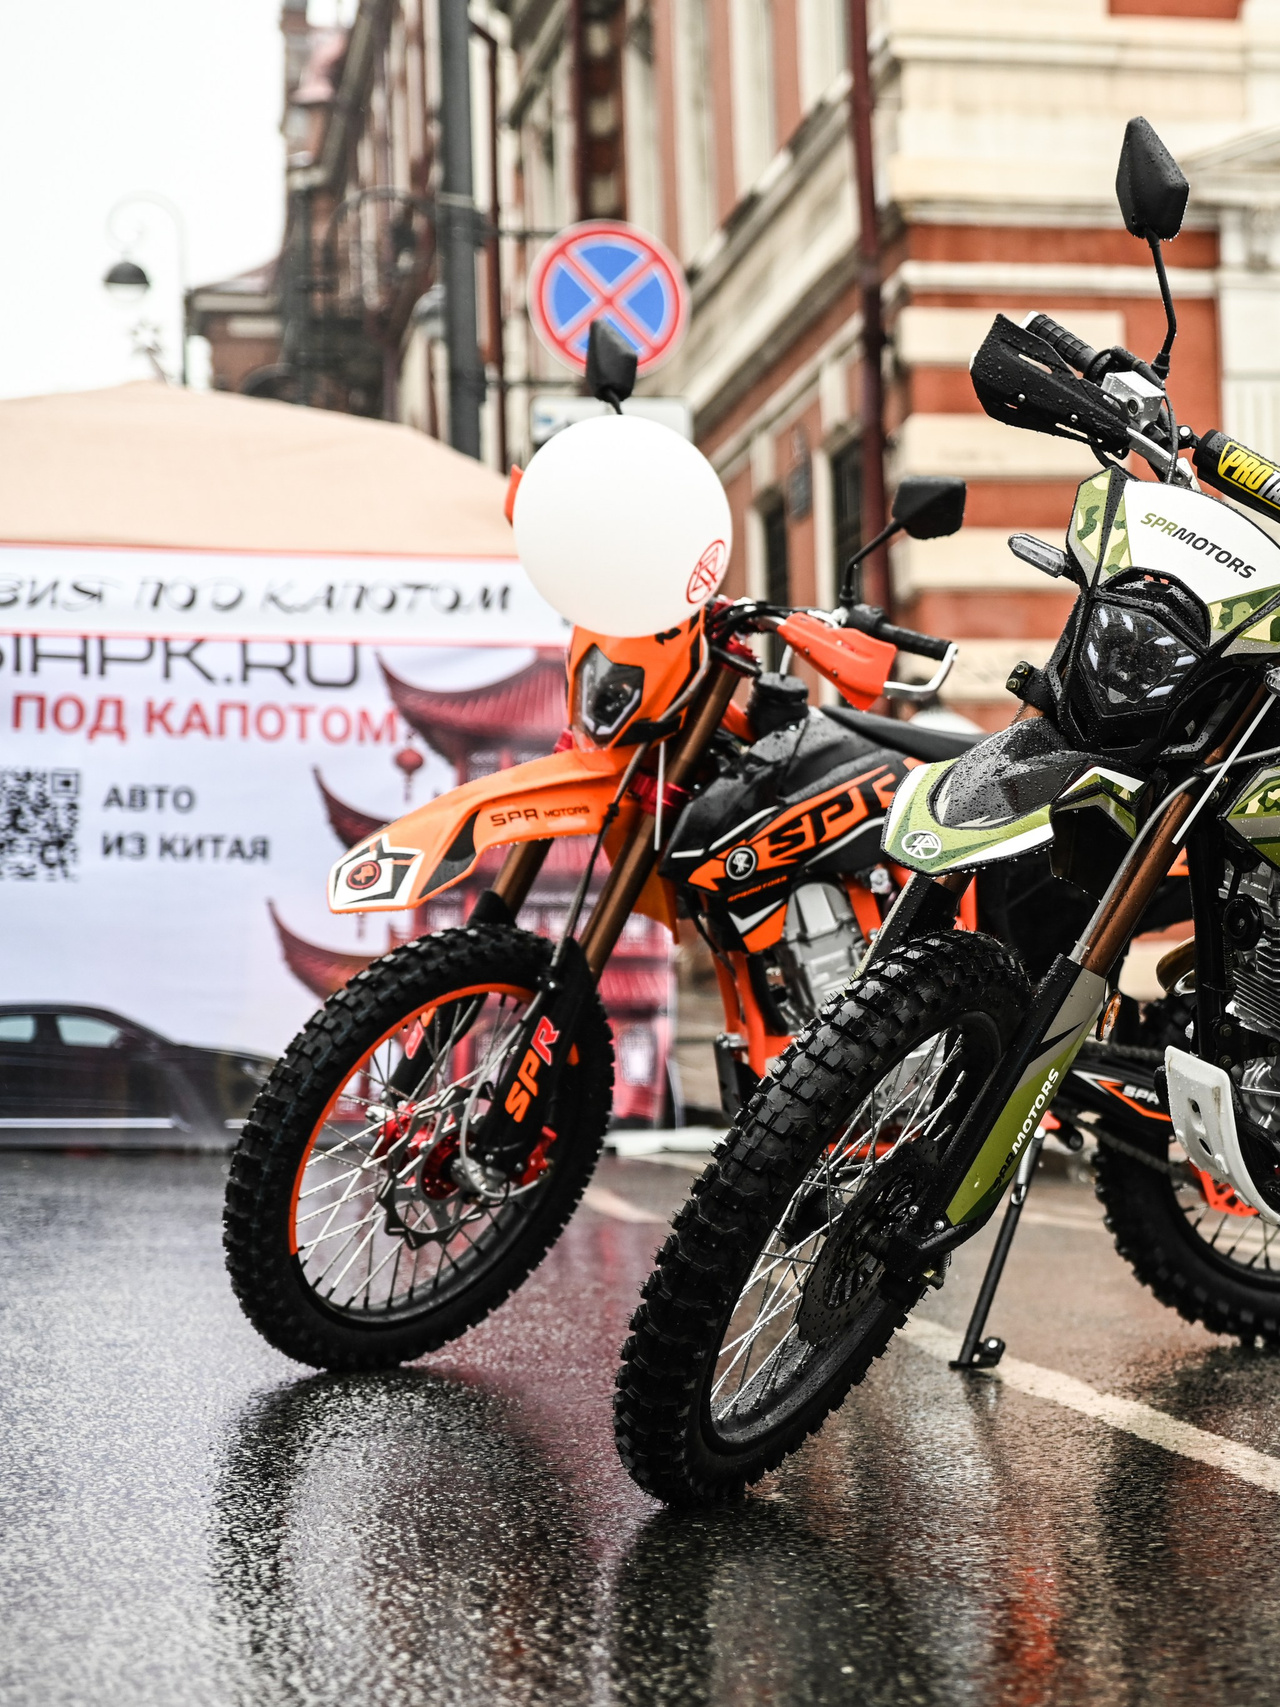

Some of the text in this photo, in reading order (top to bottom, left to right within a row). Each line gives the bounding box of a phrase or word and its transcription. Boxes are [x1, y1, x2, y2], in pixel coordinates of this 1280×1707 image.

[1140, 512, 1257, 579] SPRMOTORS
[11, 691, 398, 745] ПОД КАПОТОМ
[102, 783, 196, 814] АВТО
[490, 805, 590, 827] SPR MOTORS
[102, 832, 270, 864] ИЗ КИТАЯ
[504, 1016, 561, 1123] SPR
